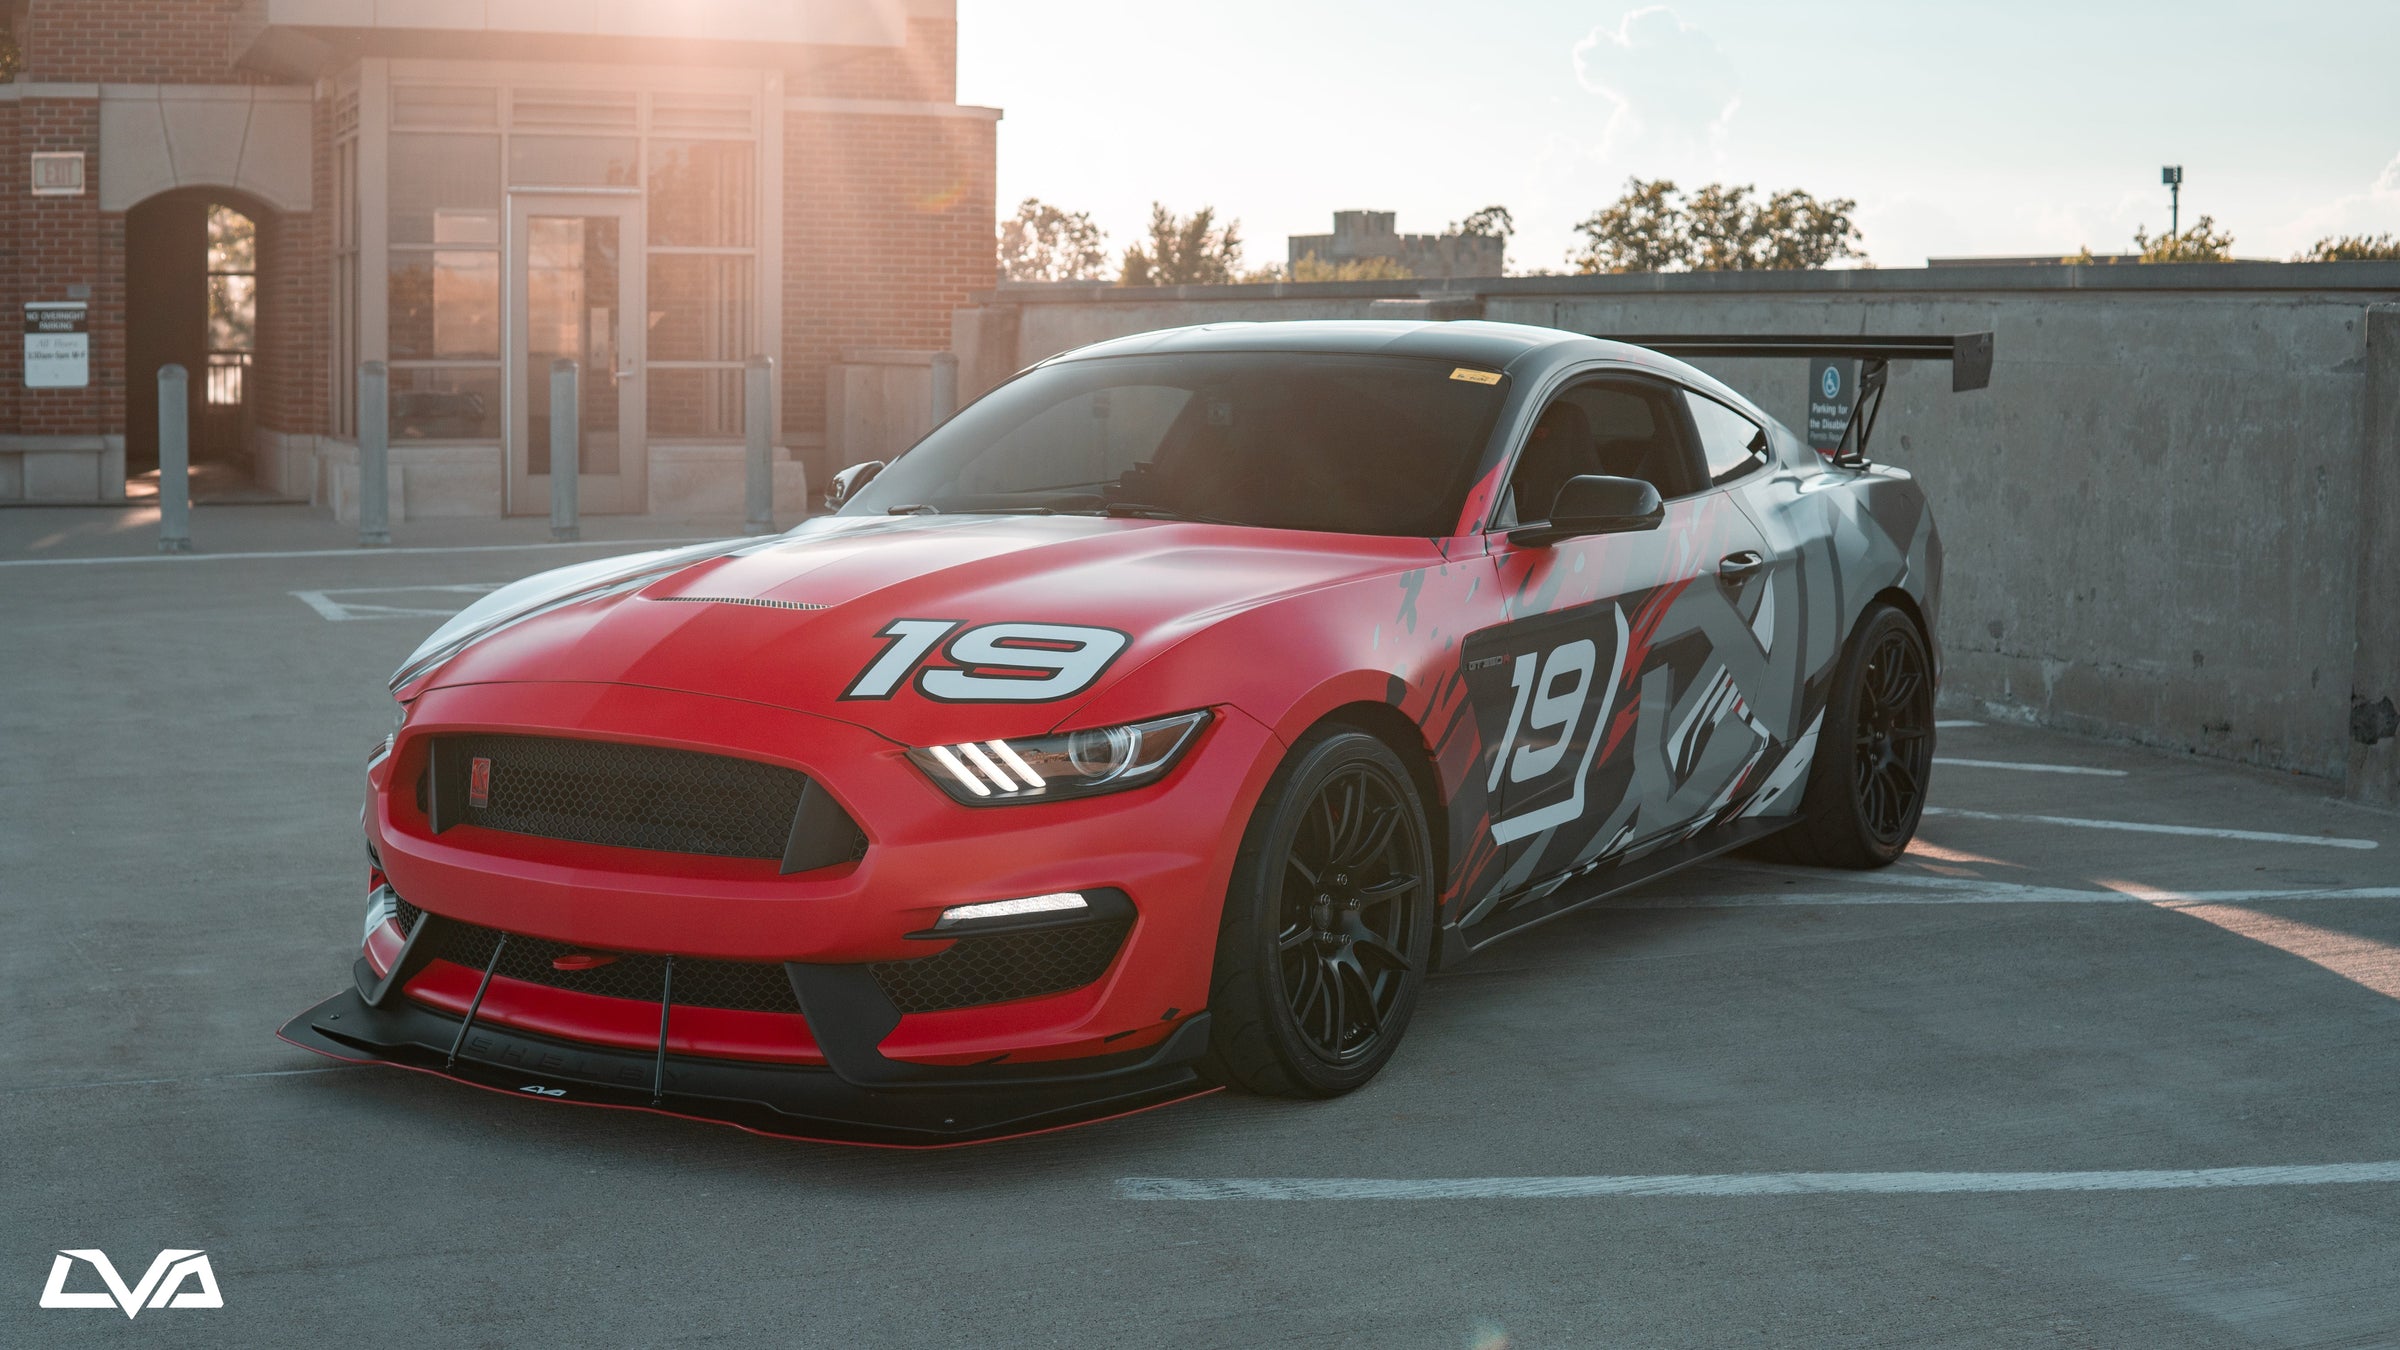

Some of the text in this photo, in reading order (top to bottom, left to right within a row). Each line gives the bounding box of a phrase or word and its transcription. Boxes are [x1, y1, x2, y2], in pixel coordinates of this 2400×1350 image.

[26, 311, 85, 320] NO OVERNIGHT
[39, 320, 73, 330] PARKING
[1812, 402, 1848, 416] Parking for
[1810, 418, 1848, 429] the Disable
[836, 618, 1134, 704] 19
[1487, 638, 1596, 793] 19
